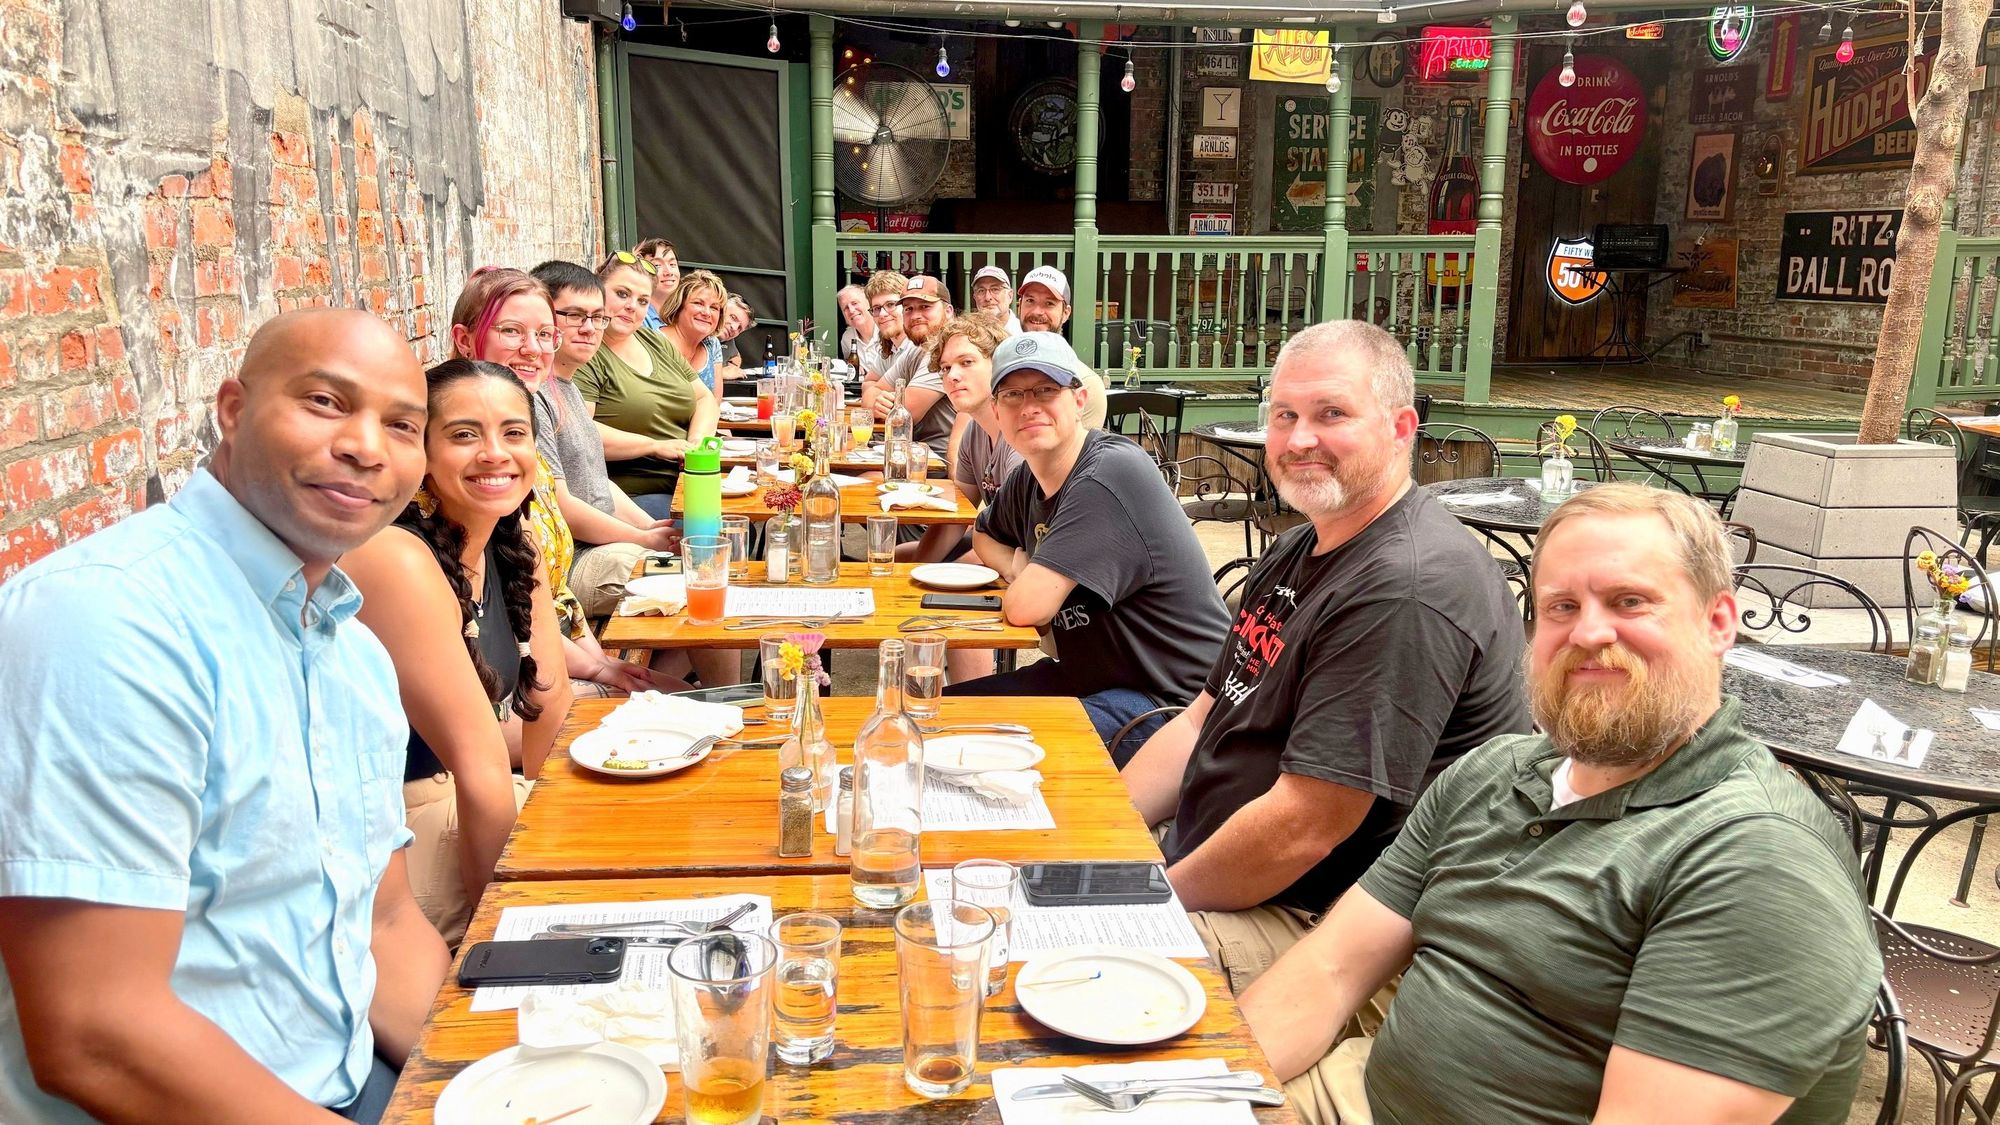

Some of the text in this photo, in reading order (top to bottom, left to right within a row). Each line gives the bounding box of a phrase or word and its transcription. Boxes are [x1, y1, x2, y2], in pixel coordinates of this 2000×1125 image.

[1886, 46, 1899, 58] 50
[1577, 76, 1611, 87] DRINK
[1541, 97, 1640, 136] Coca-Cola
[1288, 114, 1367, 140] SERCE
[1200, 140, 1230, 153] ARNLDS
[1560, 145, 1619, 156] IN BOTTLES
[1197, 184, 1214, 197] 351
[909, 219, 929, 230] you
[1831, 214, 1893, 246] RITZ
[1564, 246, 1584, 257] FIFTY
[1786, 256, 1853, 295] BALL
